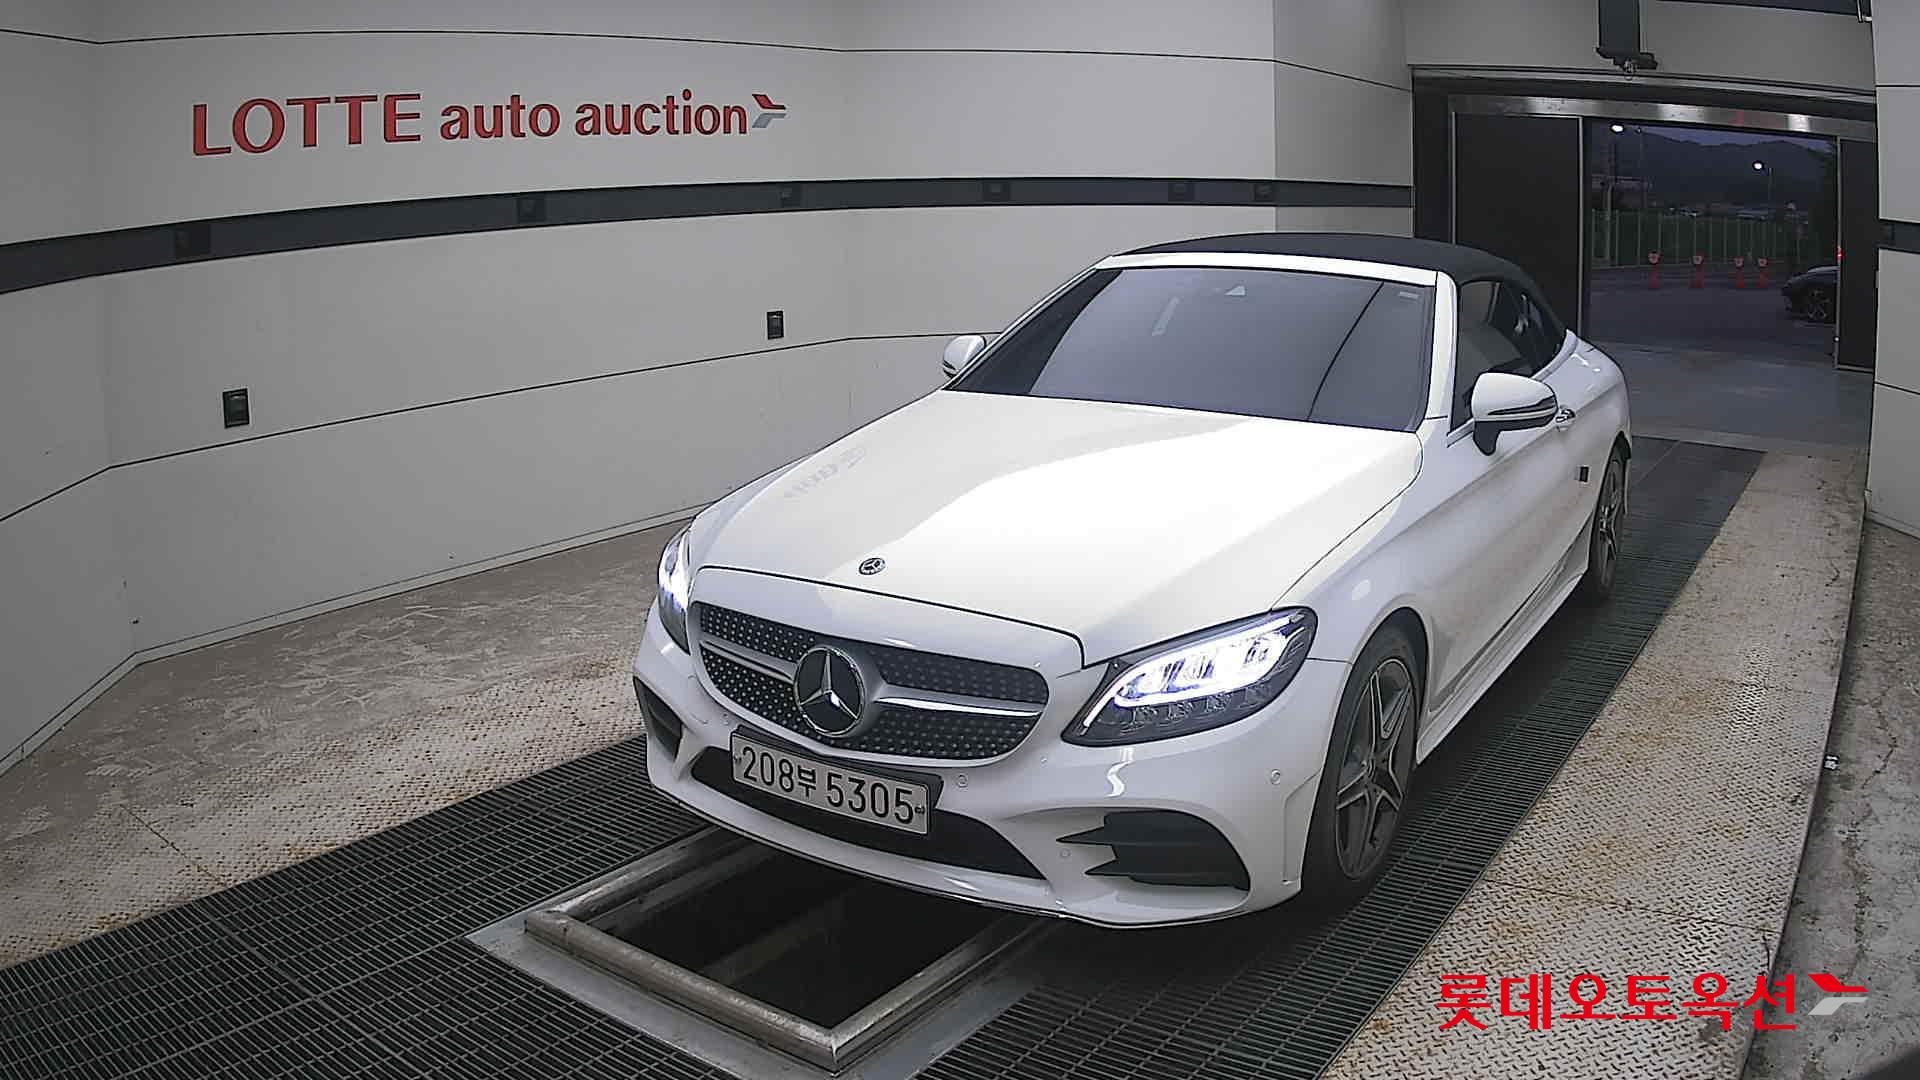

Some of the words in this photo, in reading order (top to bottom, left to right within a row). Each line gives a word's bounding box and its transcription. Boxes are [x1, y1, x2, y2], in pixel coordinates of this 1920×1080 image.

[192, 93, 422, 156] LOTTE
[439, 94, 561, 140] auto
[574, 89, 748, 136] auction
[742, 746, 817, 798] 208부
[826, 771, 914, 824] 5305
